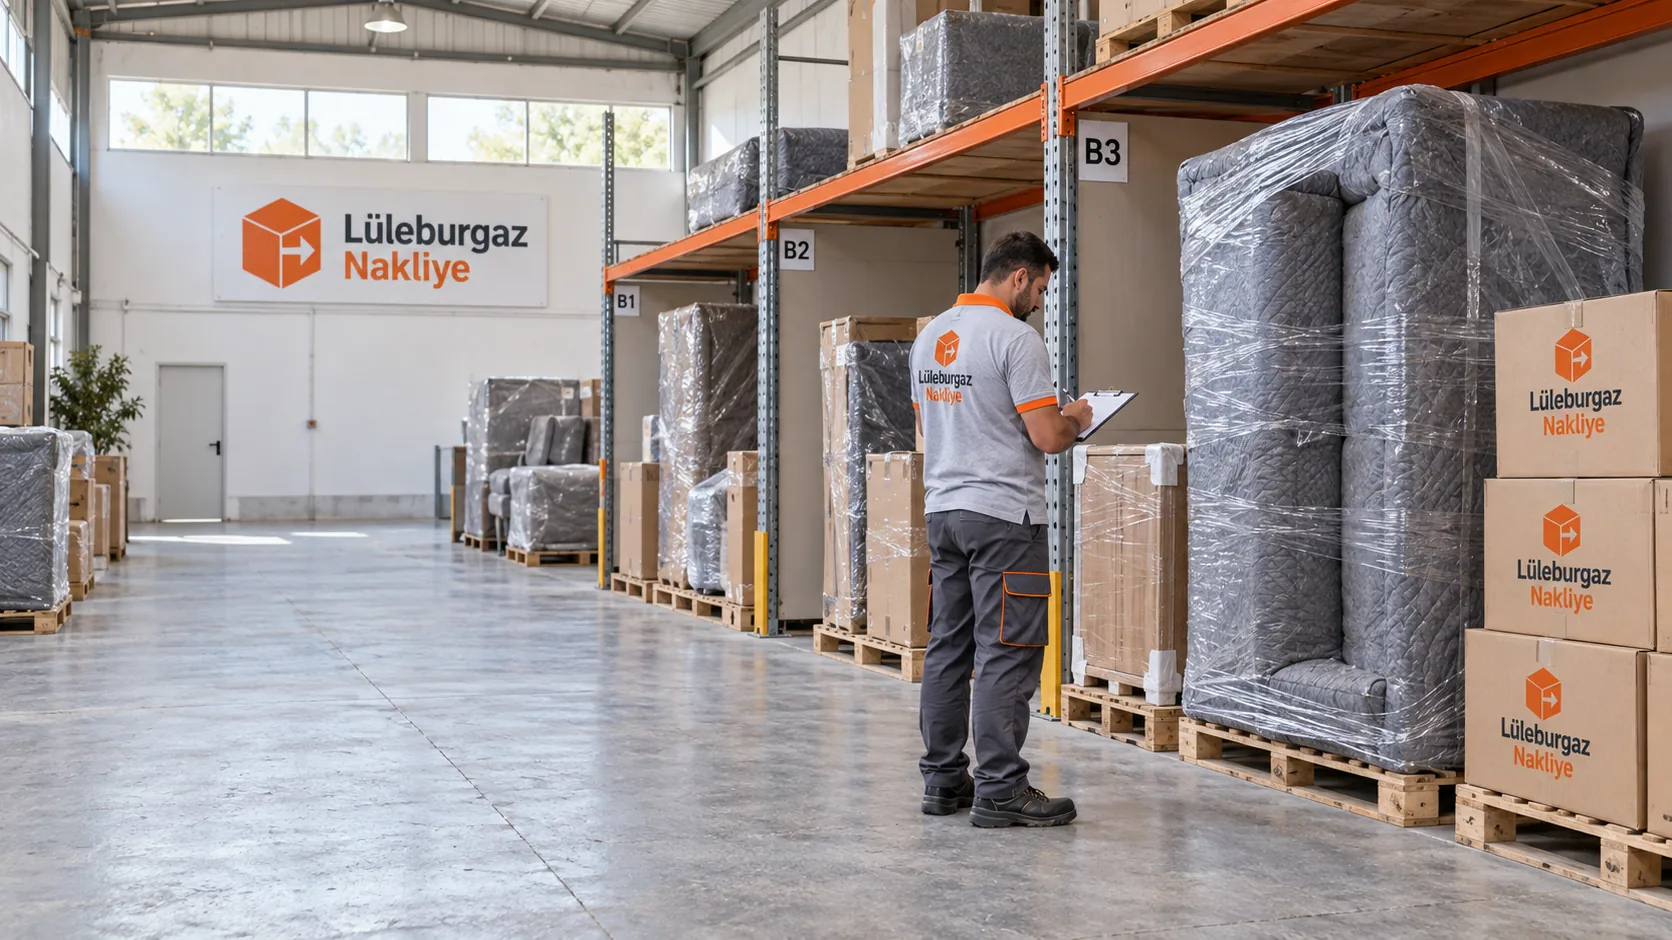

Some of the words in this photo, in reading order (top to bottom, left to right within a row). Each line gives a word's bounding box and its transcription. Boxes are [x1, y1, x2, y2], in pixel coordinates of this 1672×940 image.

[1084, 137, 1122, 167] B3
[344, 213, 528, 254] Lüleburgaz
[784, 241, 810, 260] B2
[344, 250, 470, 289] Nakliye
[618, 294, 635, 309] B1
[918, 369, 973, 389] Lüleburgaz
[1530, 387, 1622, 412] Lüleburgaz
[1543, 413, 1605, 439] Nakliye
[1517, 559, 1612, 589] Lüleburgaz
[1530, 585, 1594, 615] Nakliye
[1501, 717, 1591, 757] Lüleburgaz
[1513, 745, 1574, 780] Nakliye
